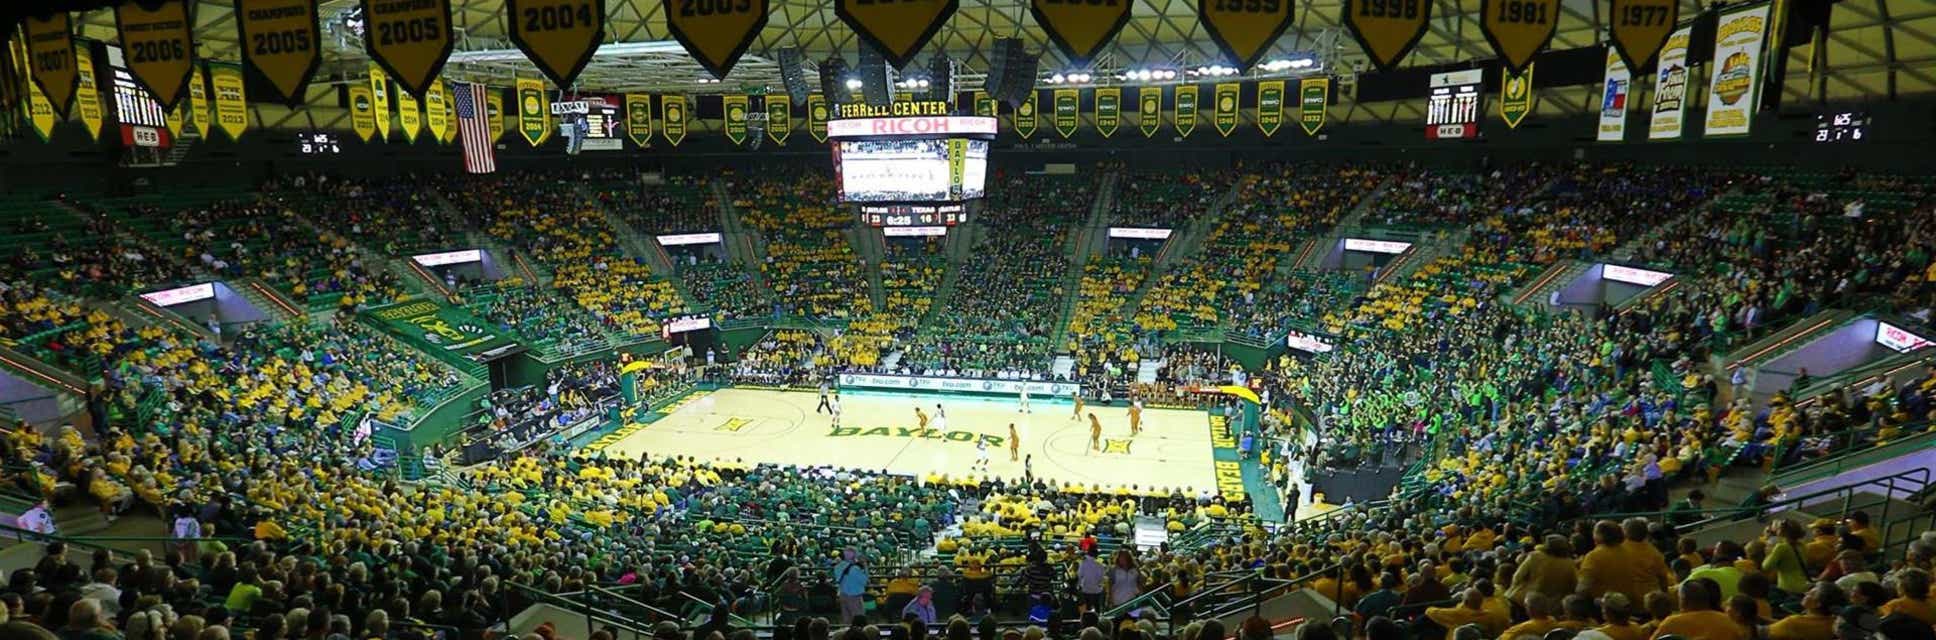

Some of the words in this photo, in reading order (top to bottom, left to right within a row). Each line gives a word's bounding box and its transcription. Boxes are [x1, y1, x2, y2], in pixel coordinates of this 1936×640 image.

[524, 3, 592, 31] 2004
[1620, 6, 1667, 27] 1977
[253, 29, 309, 54] 2005
[379, 18, 439, 46] 2005
[132, 40, 184, 62] 2006
[842, 104, 889, 117] FERRELL
[894, 102, 946, 115] CENTER
[872, 119, 949, 133] RICOH
[828, 427, 1006, 446] BAYLOR
